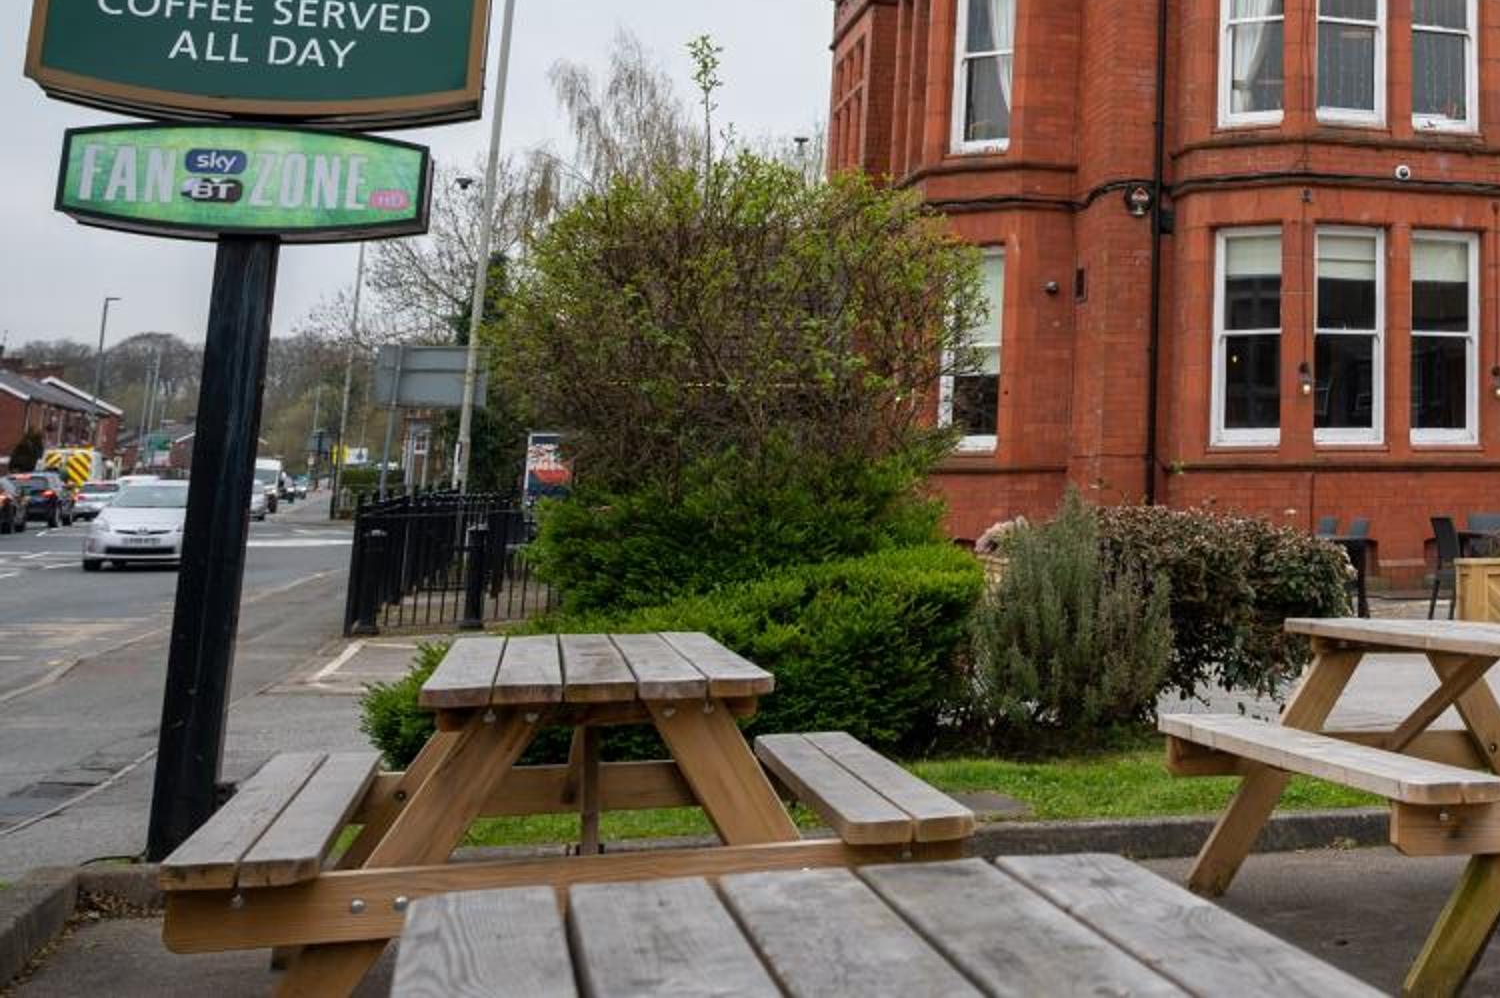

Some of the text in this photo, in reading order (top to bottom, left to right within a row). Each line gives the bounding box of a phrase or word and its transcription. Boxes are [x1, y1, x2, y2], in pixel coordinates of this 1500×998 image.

[168, 30, 358, 69] ALL DAY
[197, 151, 237, 172] sky
[78, 144, 369, 210] FAN ZONE
[191, 182, 236, 199] BT
